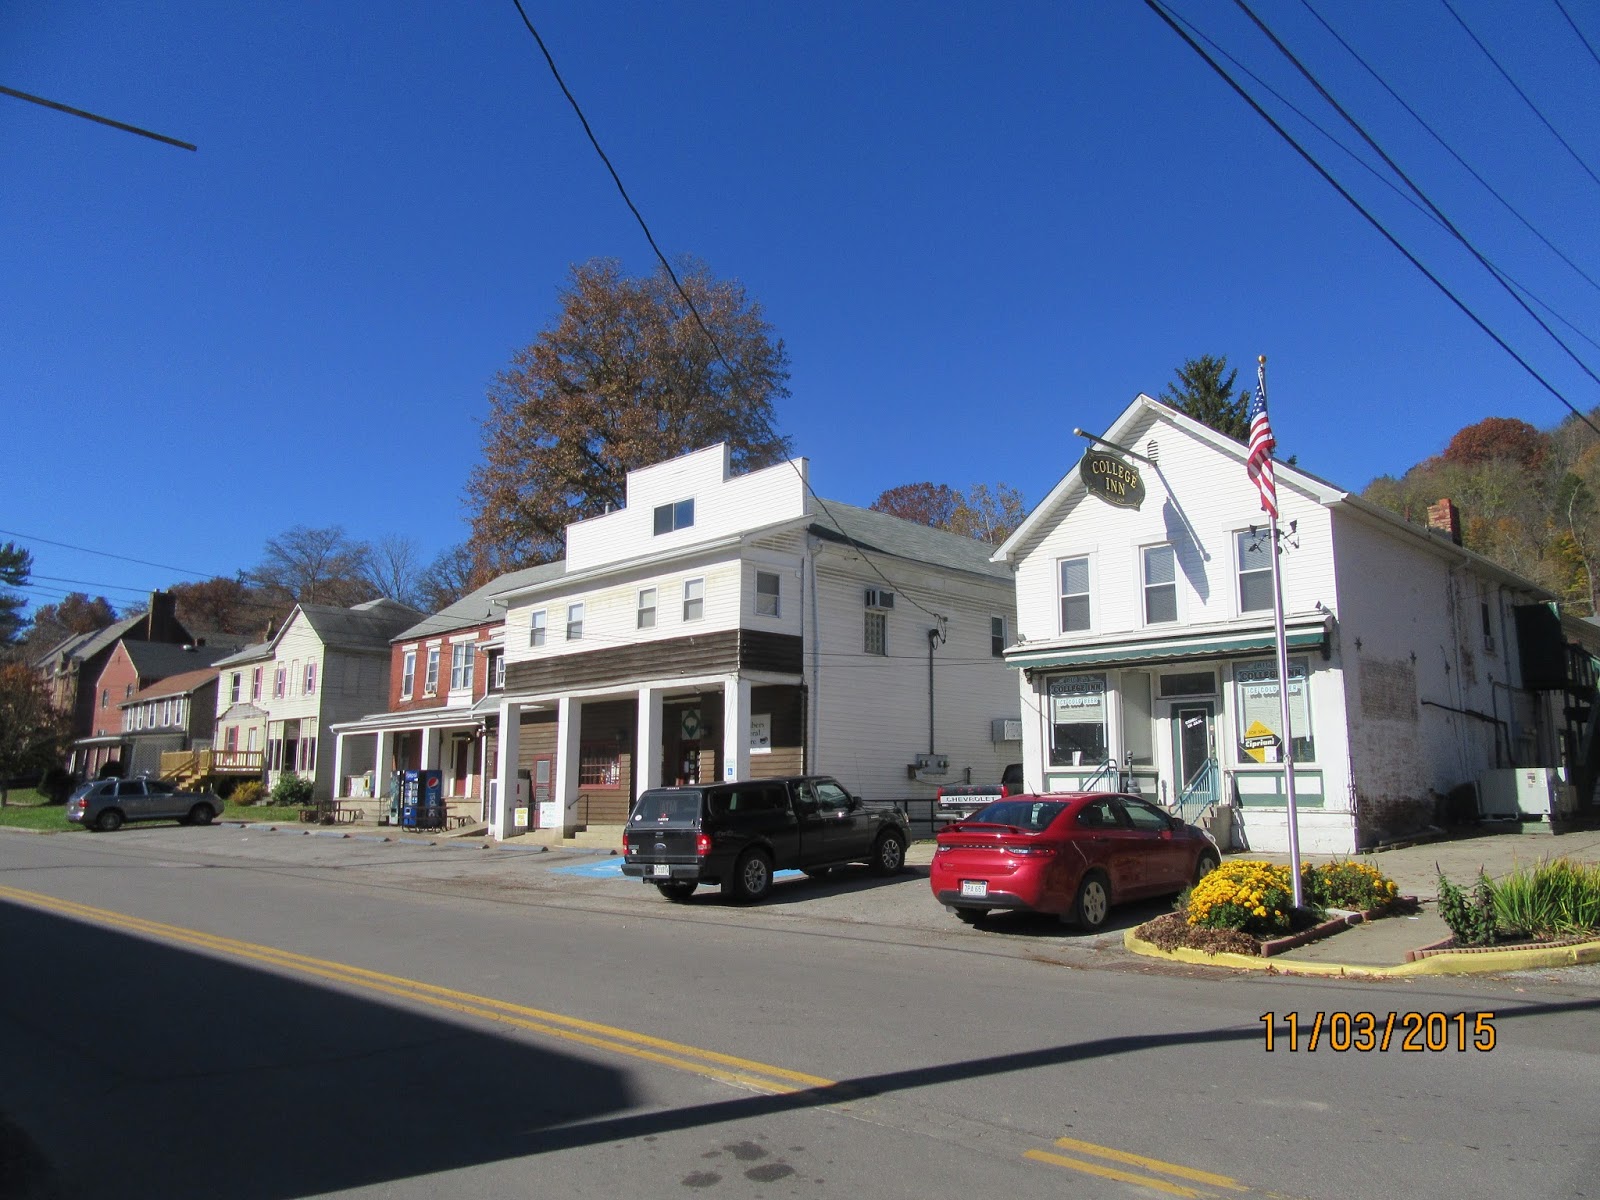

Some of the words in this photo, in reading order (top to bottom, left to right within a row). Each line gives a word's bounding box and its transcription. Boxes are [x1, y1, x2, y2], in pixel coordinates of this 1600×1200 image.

[1092, 460, 1138, 489] COLLEGE
[1105, 477, 1125, 496] INN
[1053, 684, 1086, 693] COLLEGE
[1087, 682, 1101, 692] INN
[1247, 686, 1258, 694] ICE
[1260, 685, 1278, 694] COLD
[1068, 698, 1082, 706] COLD
[1082, 696, 1099, 705] BEER
[1245, 737, 1275, 749] Cipriani
